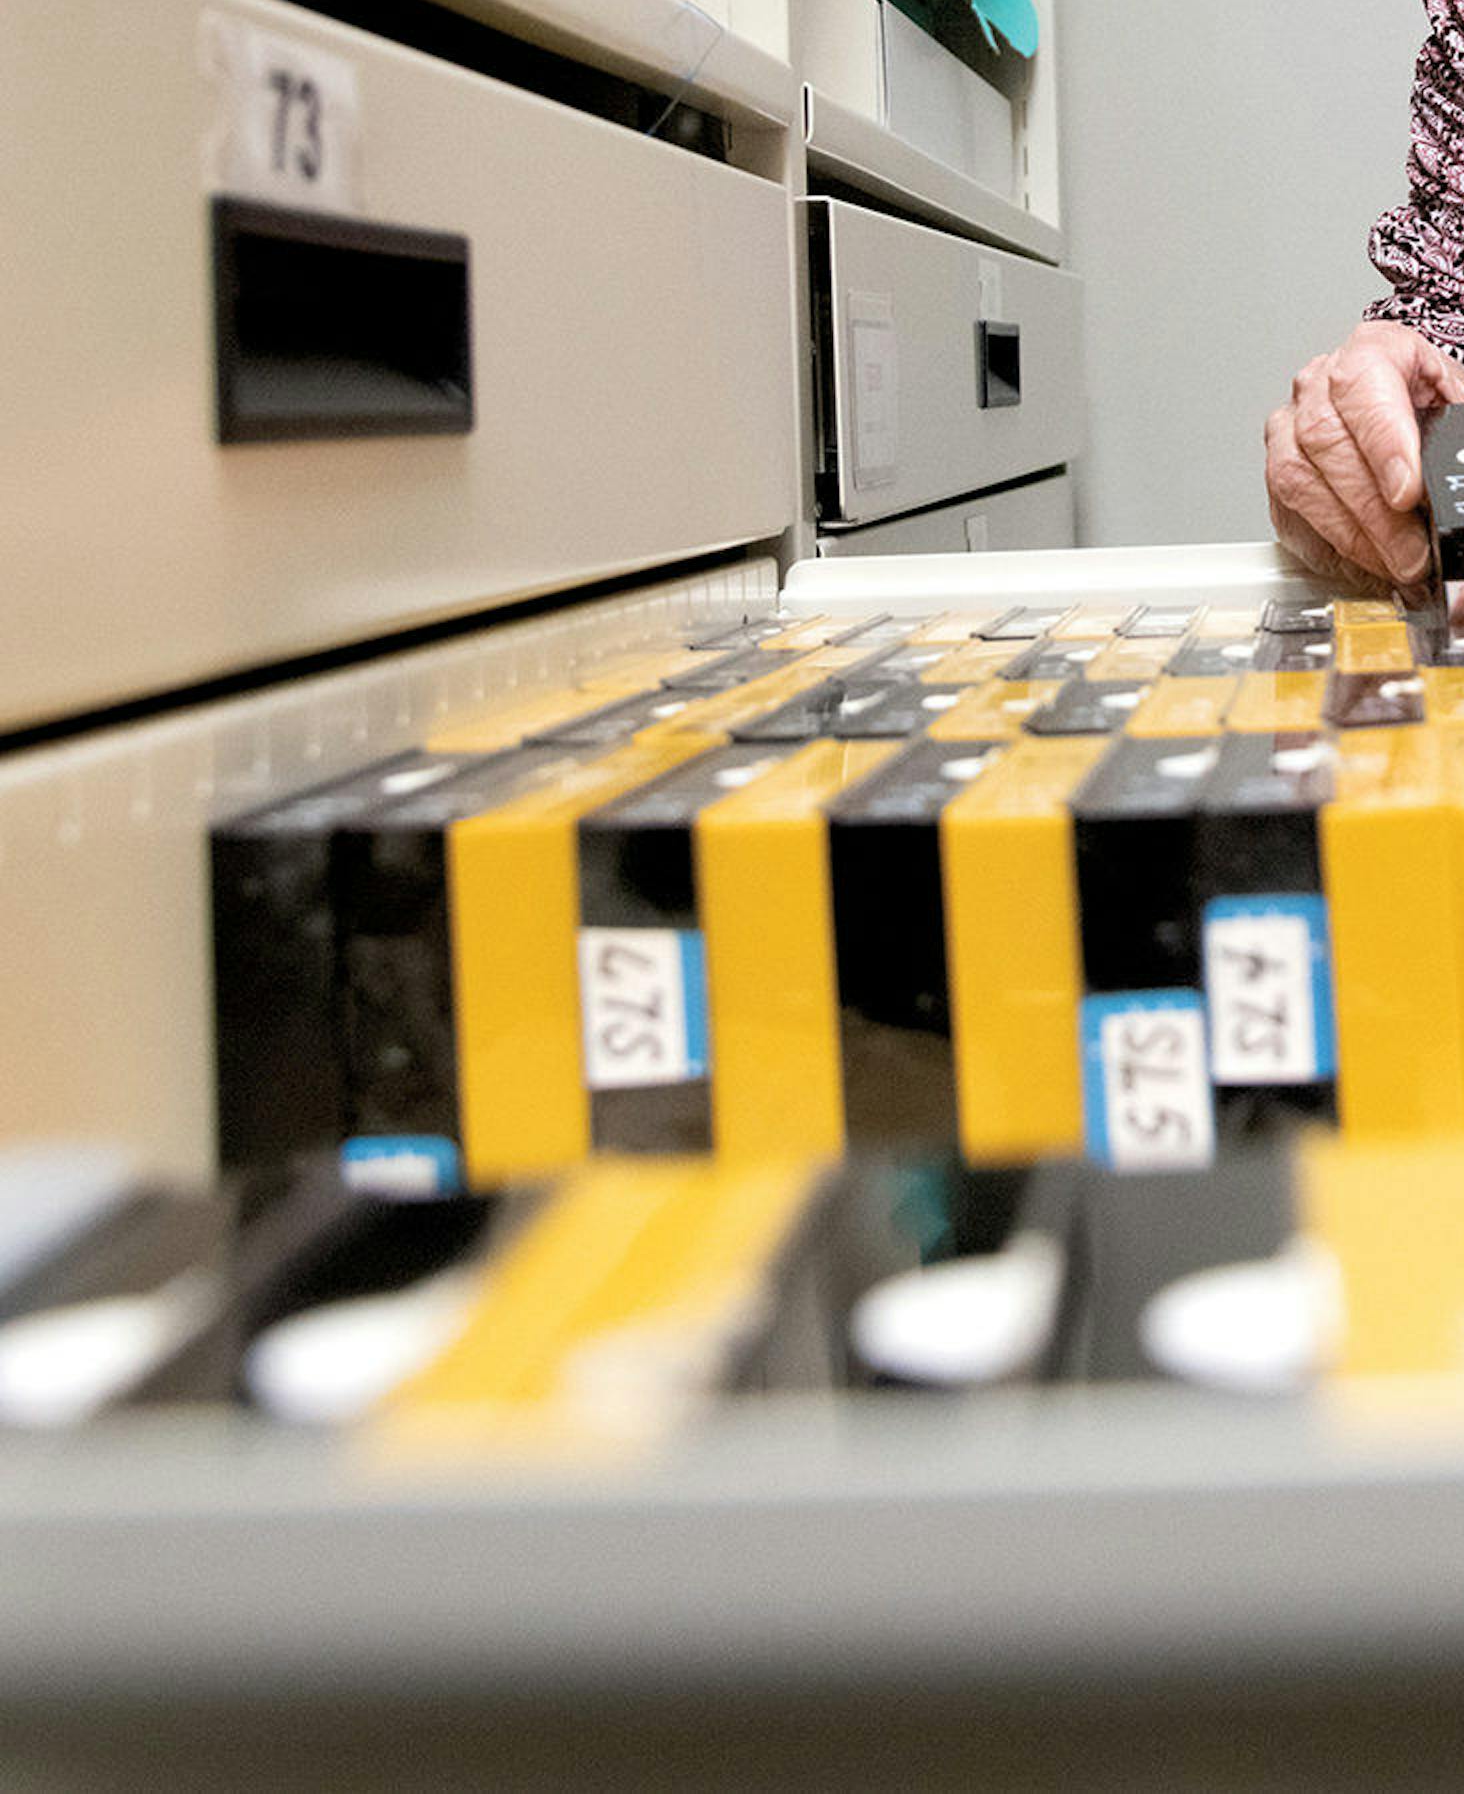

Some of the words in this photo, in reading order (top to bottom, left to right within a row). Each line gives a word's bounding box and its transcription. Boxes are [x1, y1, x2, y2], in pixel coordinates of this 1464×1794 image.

[599, 943, 663, 1064] SL7
[1221, 944, 1289, 1061] SL4
[1121, 1021, 1194, 1146] SL5
